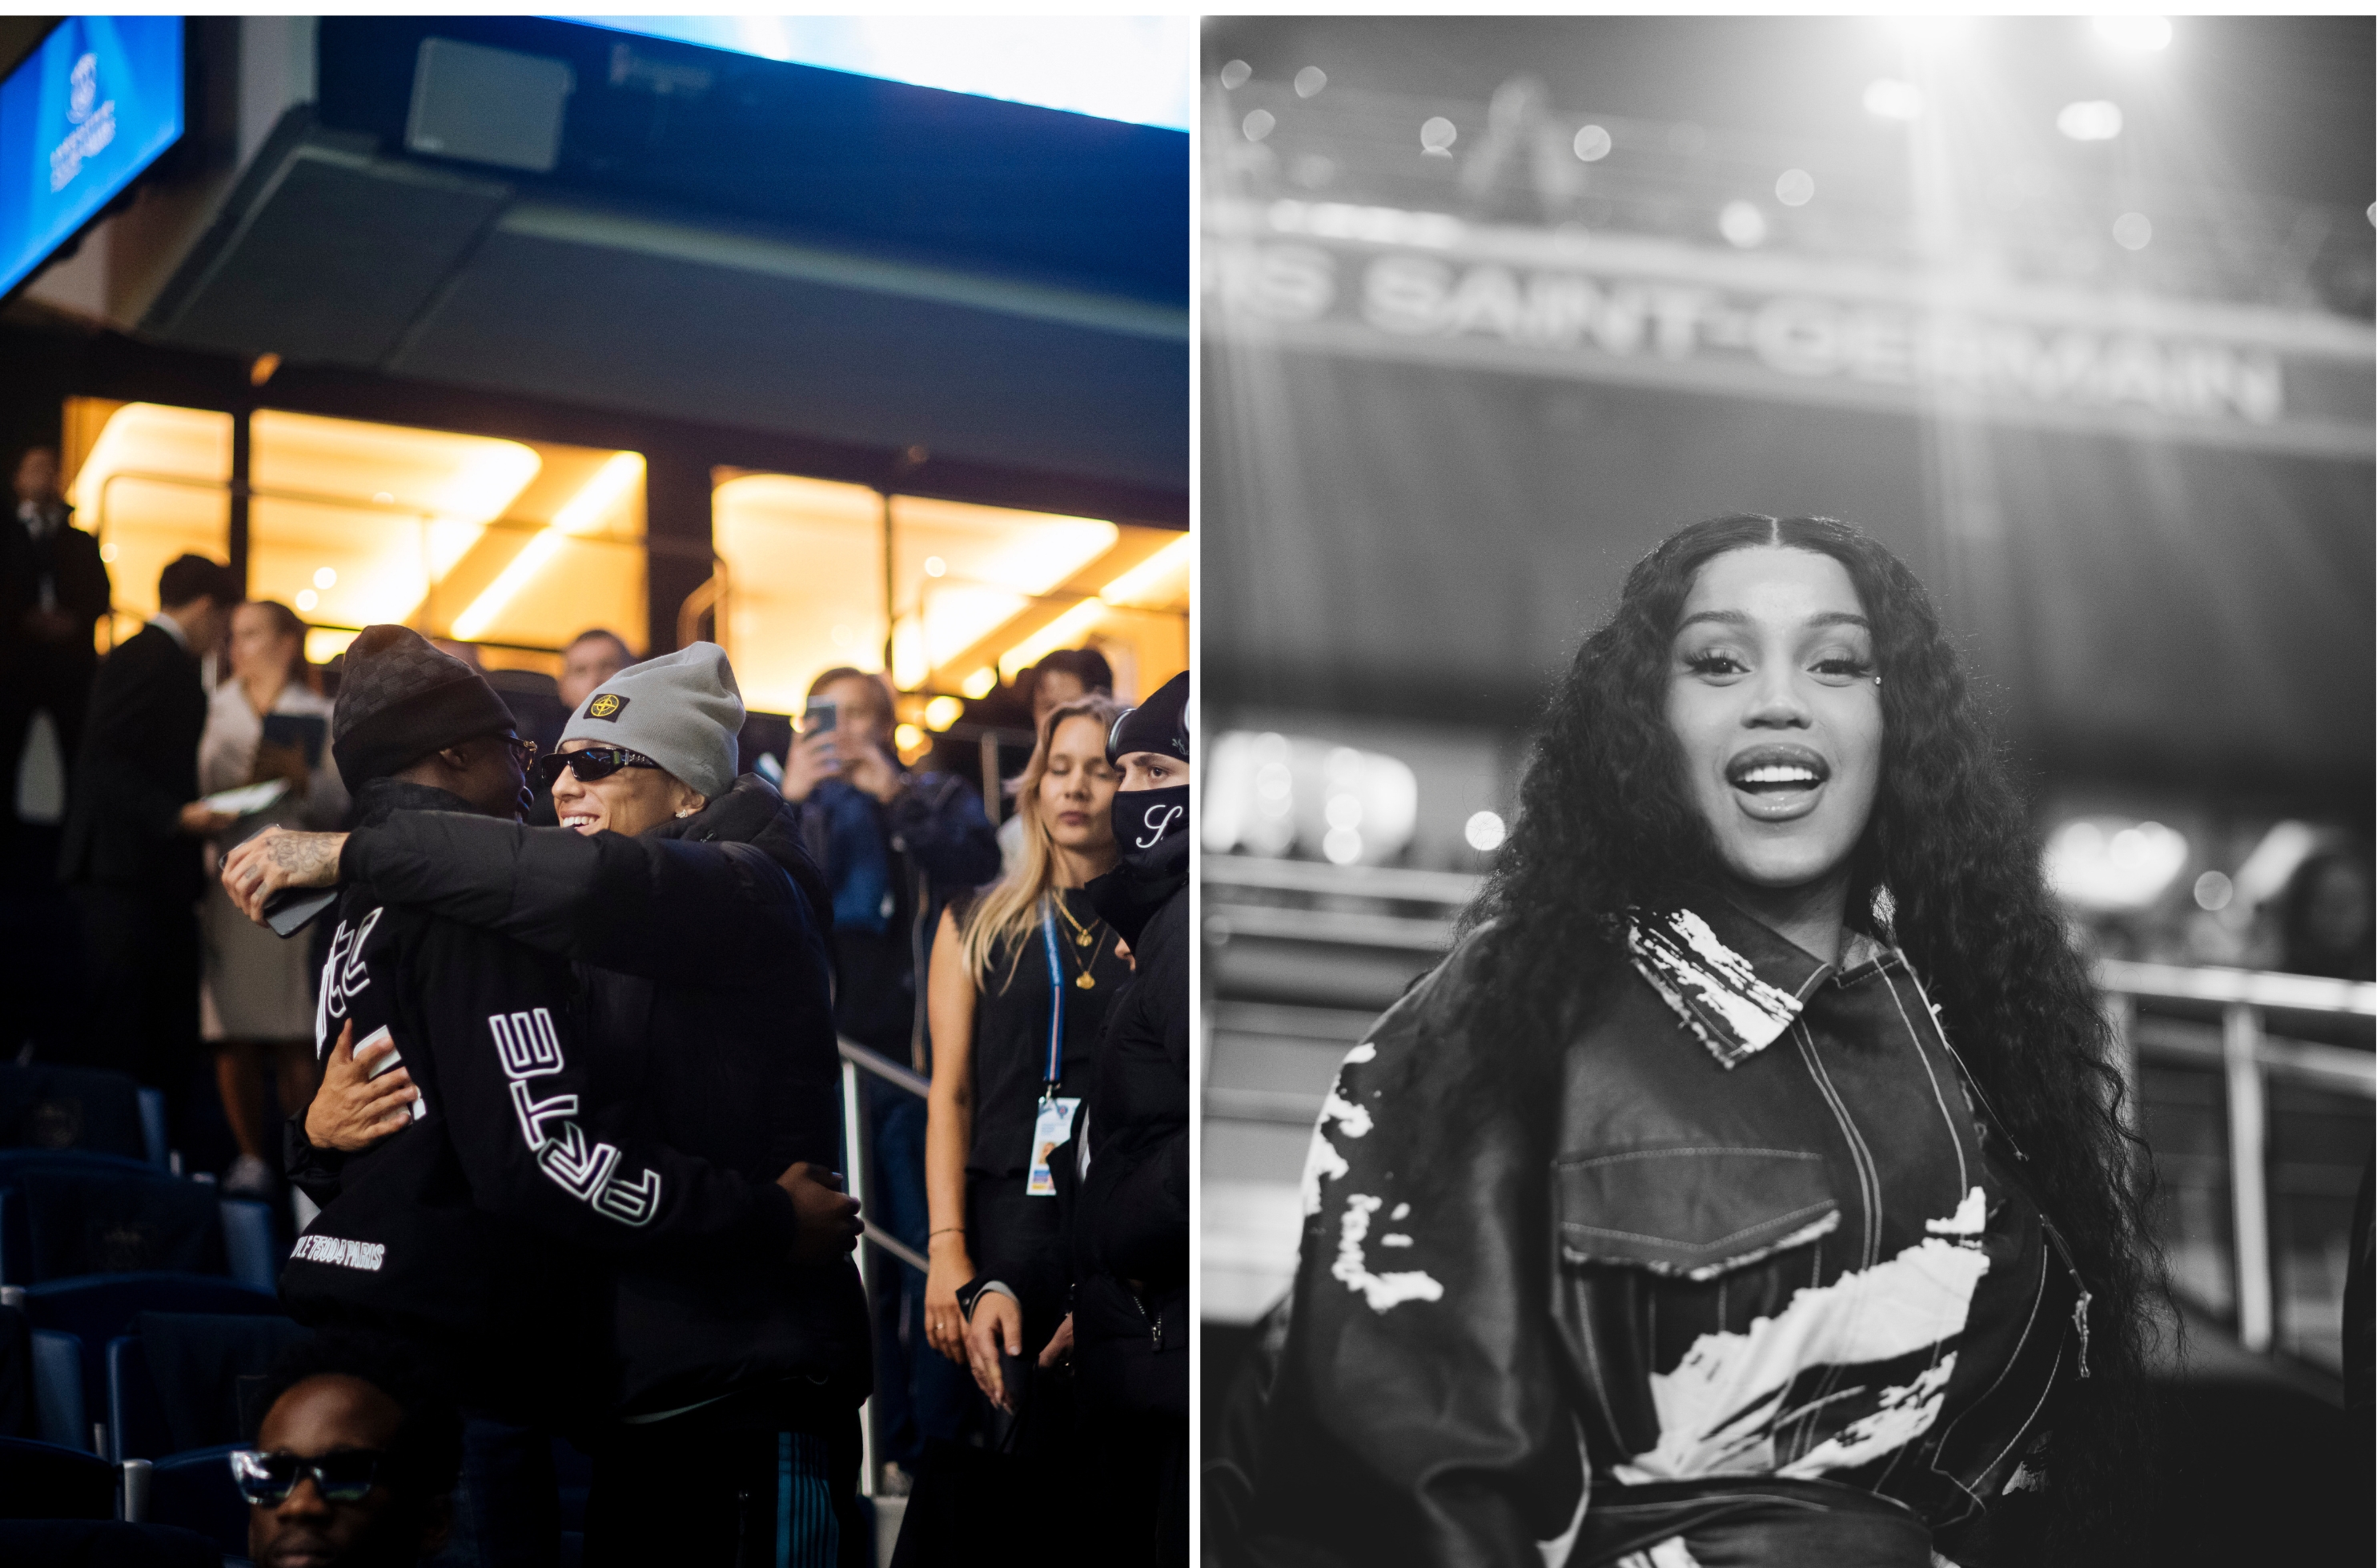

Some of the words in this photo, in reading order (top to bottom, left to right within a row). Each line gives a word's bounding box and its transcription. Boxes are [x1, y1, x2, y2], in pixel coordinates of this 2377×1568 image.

[488, 1007, 661, 1227] ARTE
[307, 1234, 347, 1265] 75004
[343, 1240, 386, 1271] PARIS
